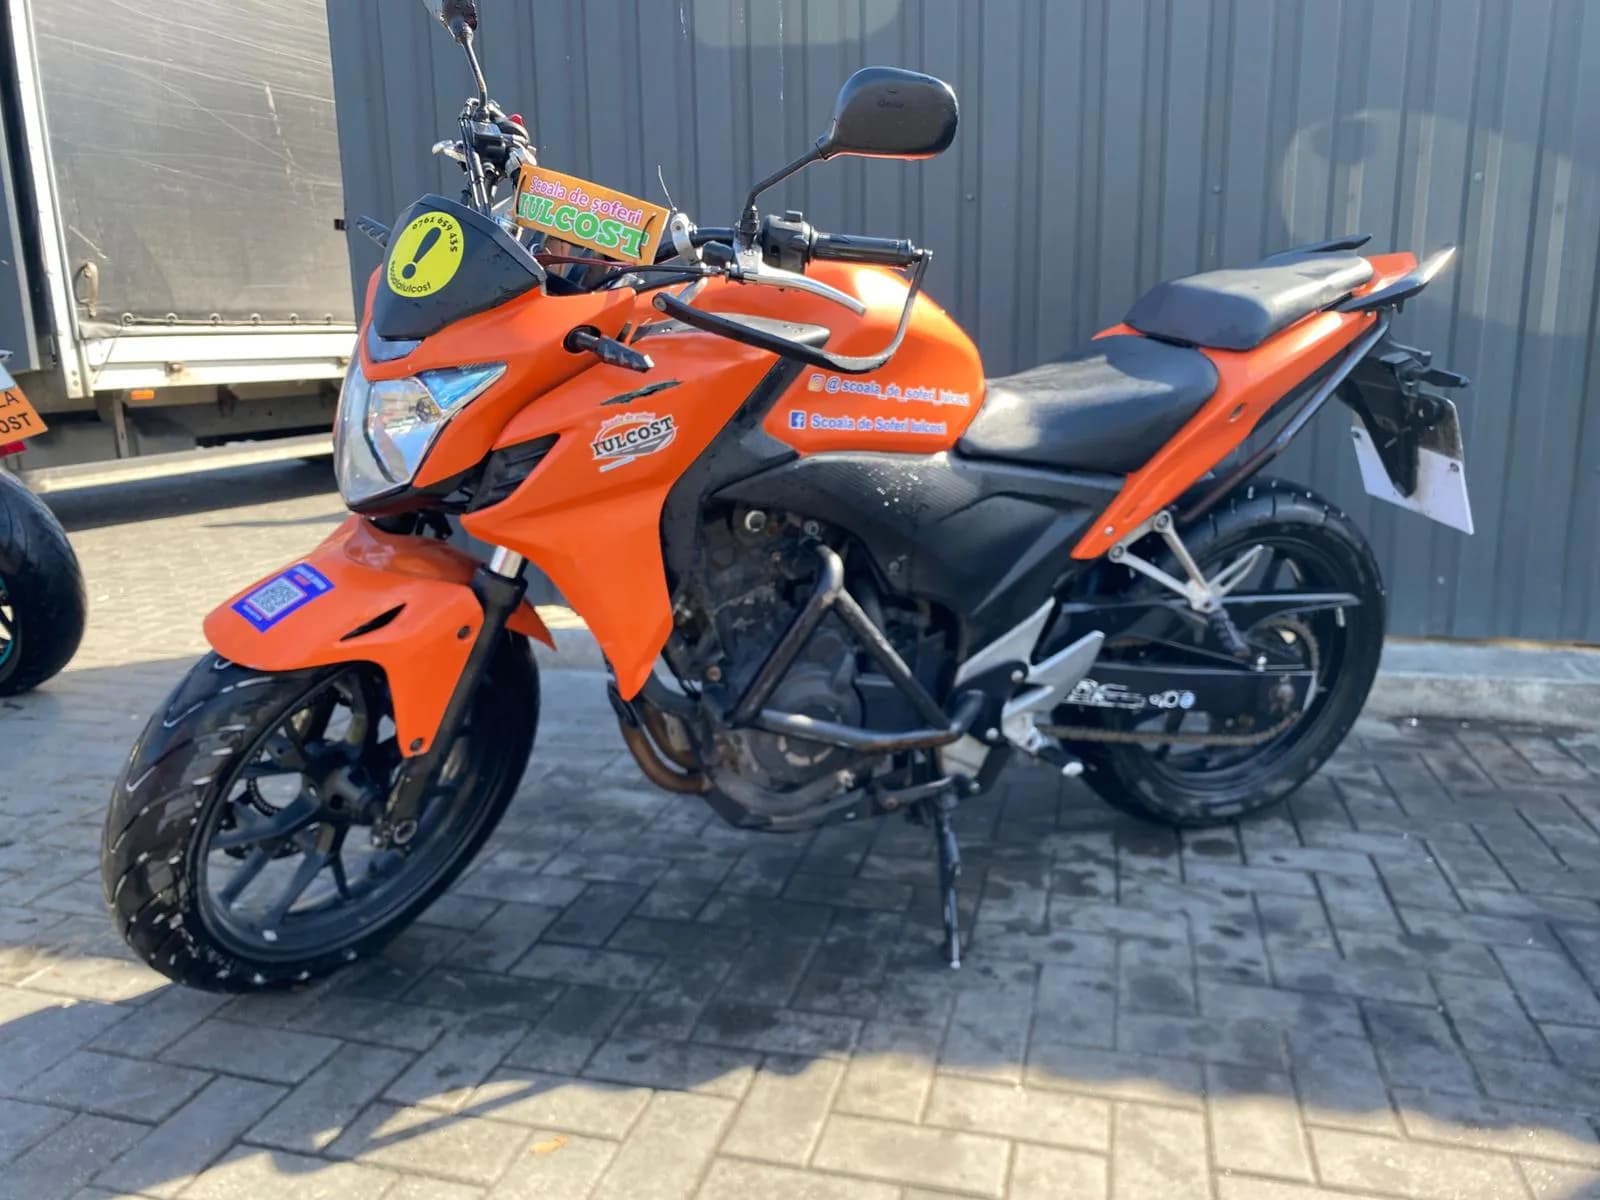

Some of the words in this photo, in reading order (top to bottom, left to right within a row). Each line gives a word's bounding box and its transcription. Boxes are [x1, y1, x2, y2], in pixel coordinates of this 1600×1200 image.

[569, 188, 589, 206] de
[438, 217, 453, 231] 659
[449, 232, 458, 253] 435
[518, 192, 649, 257] IULCOST
[592, 417, 673, 456] IULCOST
[811, 413, 853, 430] Scoala
[857, 417, 874, 430] de
